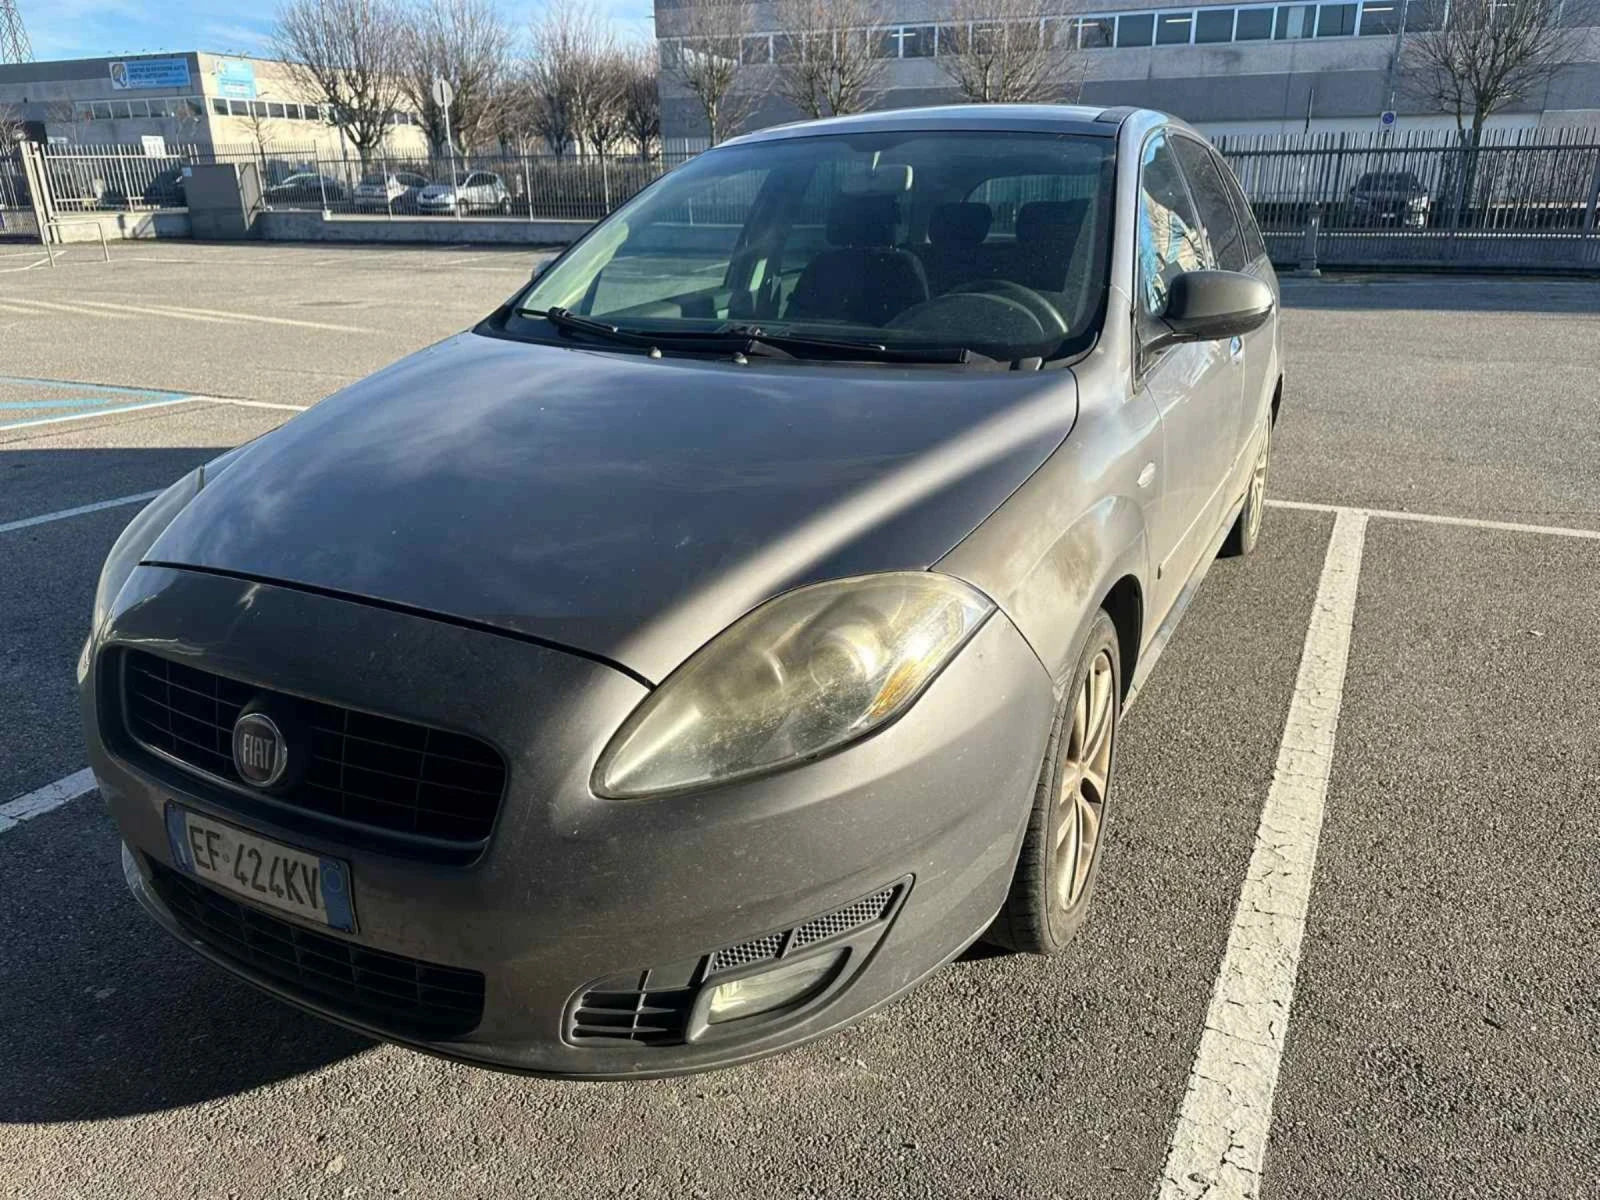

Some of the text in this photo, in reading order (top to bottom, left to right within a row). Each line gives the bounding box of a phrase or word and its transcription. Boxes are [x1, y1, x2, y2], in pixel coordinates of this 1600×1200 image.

[243, 733, 274, 770] FIAT
[189, 825, 318, 909] EF 424KV
